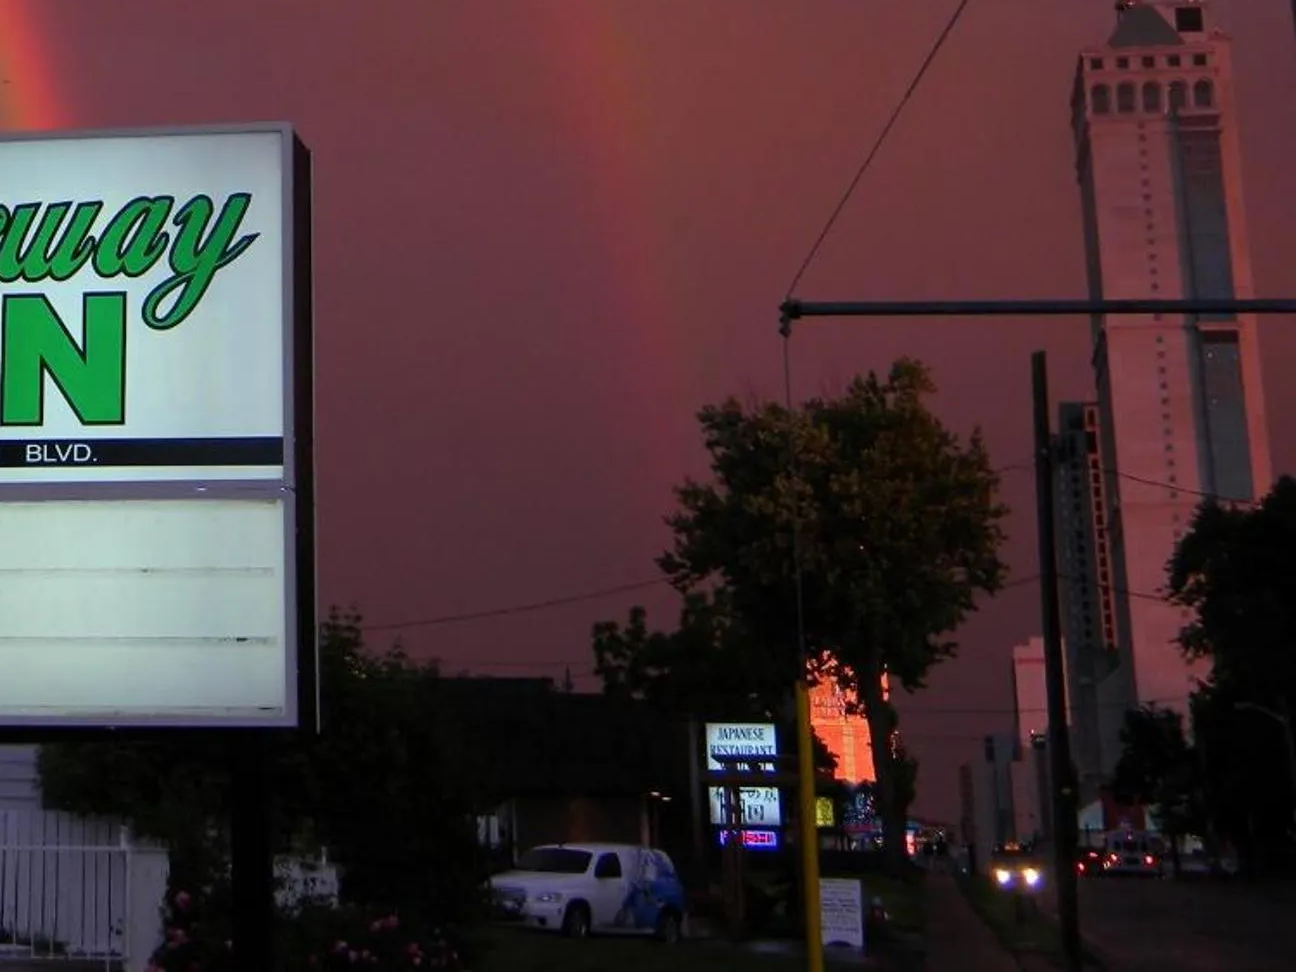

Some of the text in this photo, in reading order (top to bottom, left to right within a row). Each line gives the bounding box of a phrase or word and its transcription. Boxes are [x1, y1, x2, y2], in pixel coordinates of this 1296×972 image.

[25, 443, 98, 463] BLVD.
[717, 727, 765, 740] JAPANESE
[710, 744, 774, 756] RESTAURANT
